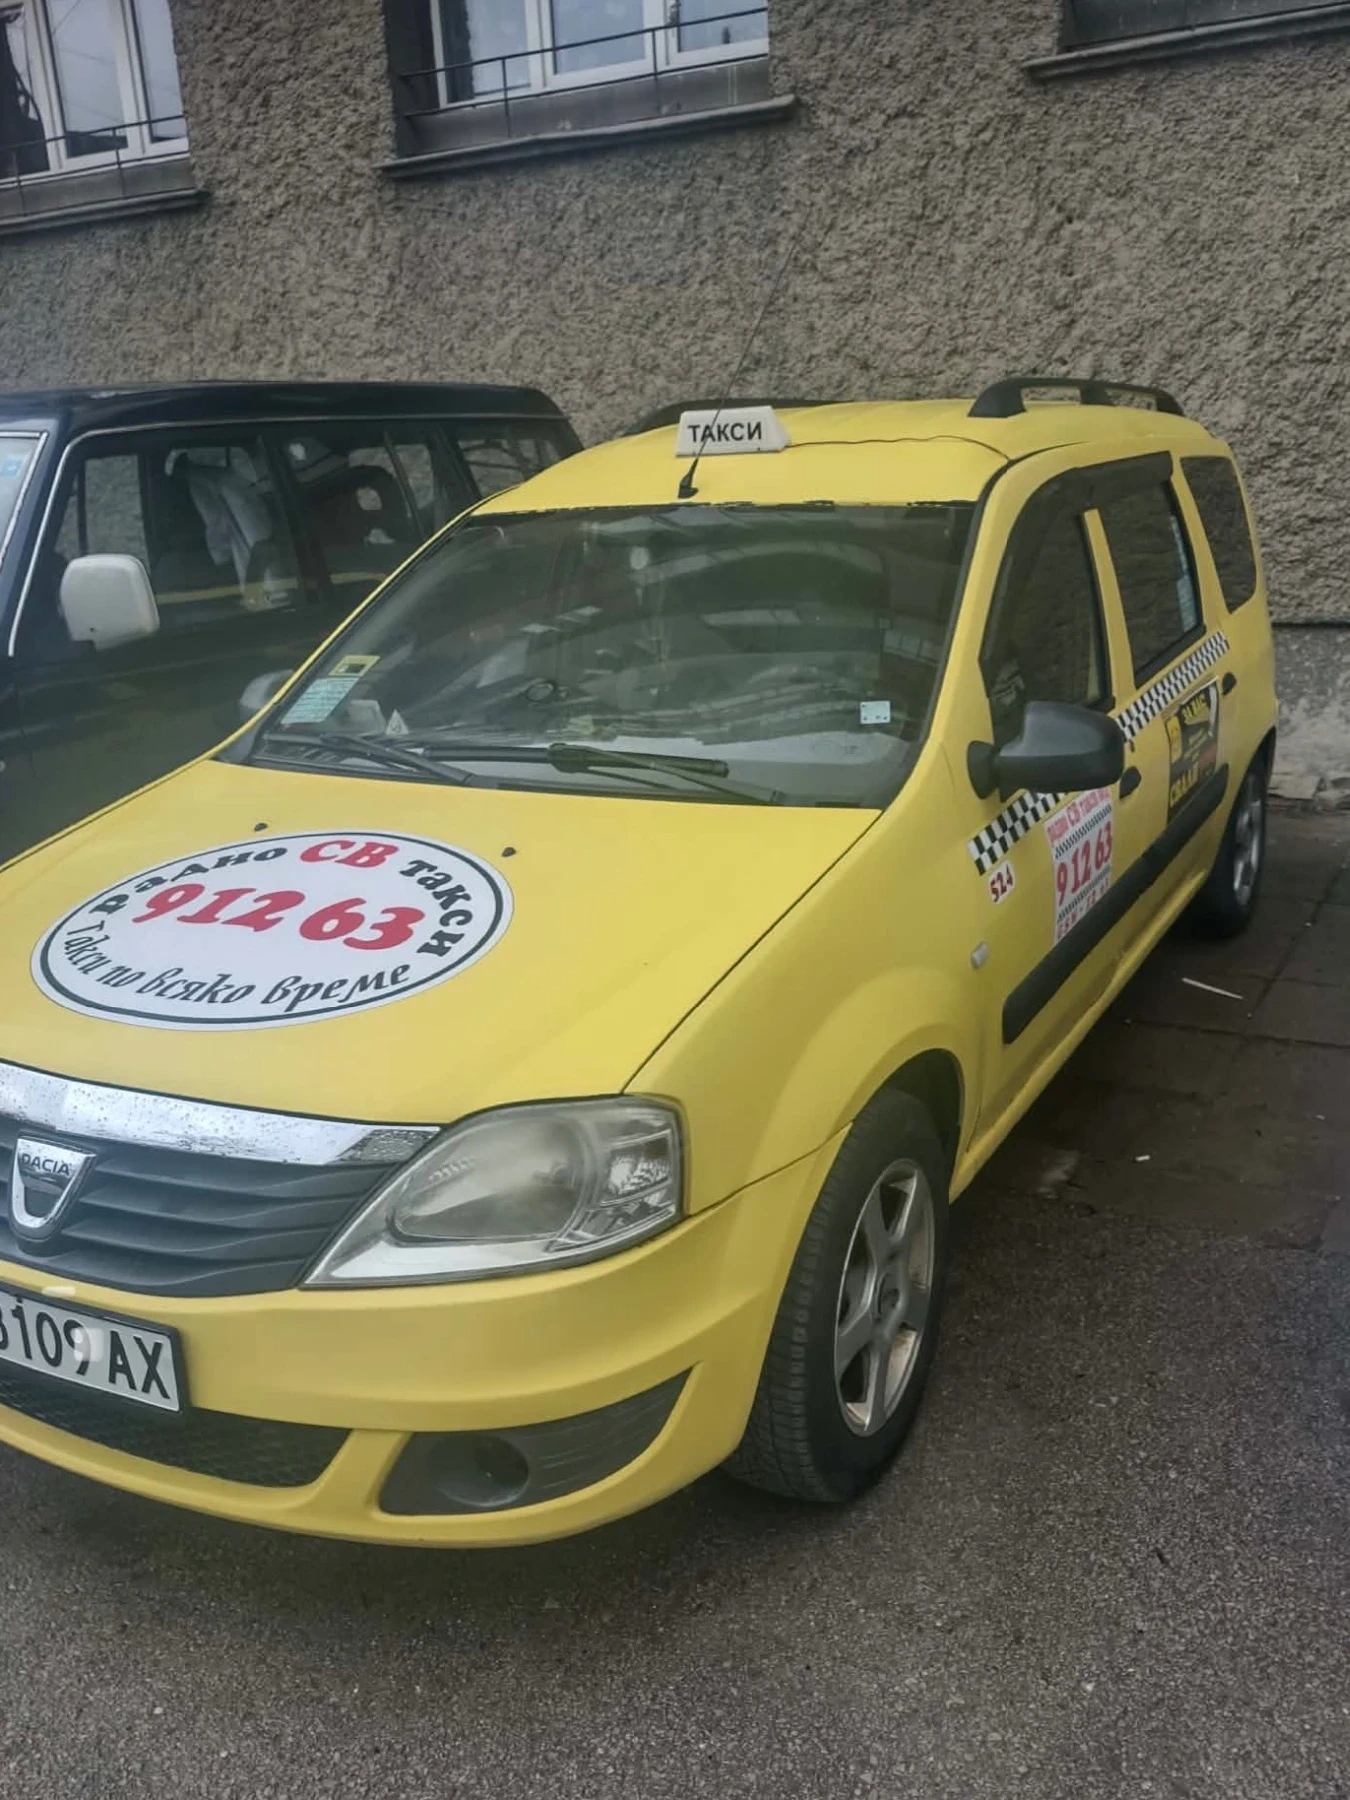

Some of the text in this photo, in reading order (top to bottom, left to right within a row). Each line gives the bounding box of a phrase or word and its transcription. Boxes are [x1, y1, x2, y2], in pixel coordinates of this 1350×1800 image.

[687, 421, 762, 443] ТАКСИ
[399, 859, 474, 958] такси
[64, 920, 411, 1013] Такси по всяко време
[21, 1152, 71, 1177] DACIA
[108, 1329, 171, 1400] AX
